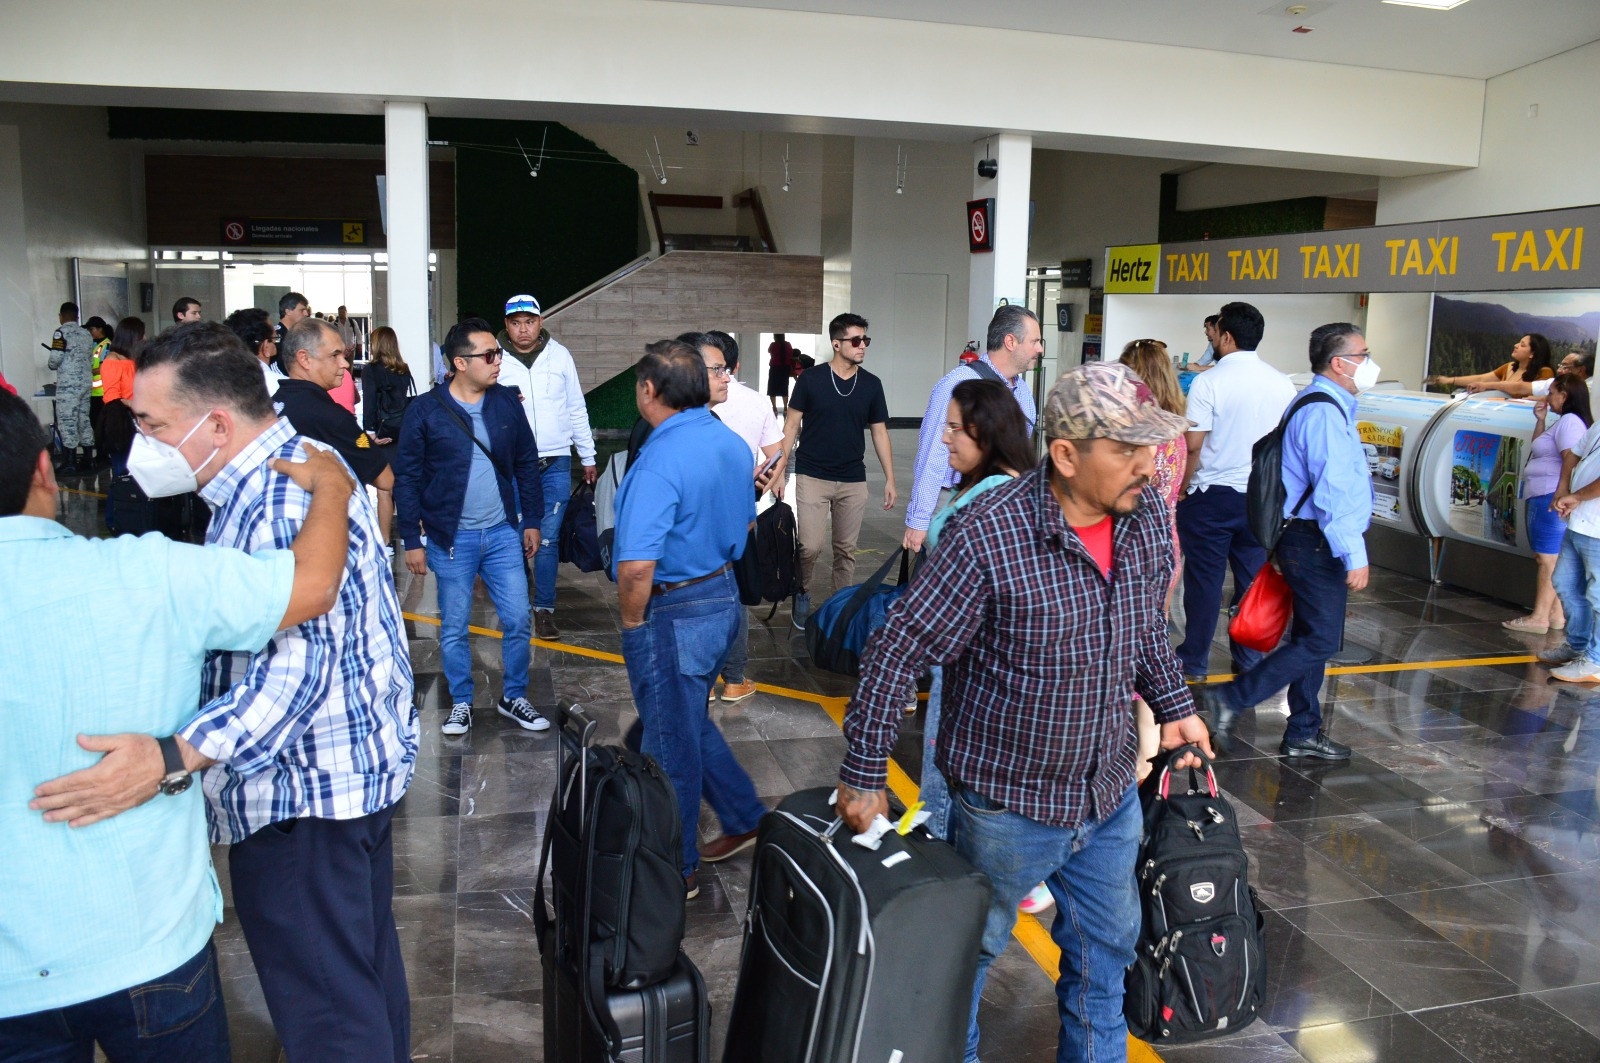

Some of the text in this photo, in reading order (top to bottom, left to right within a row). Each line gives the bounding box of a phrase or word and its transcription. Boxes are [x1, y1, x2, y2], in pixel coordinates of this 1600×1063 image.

[251, 225, 282, 233] Llegadas
[1166, 227, 1585, 282] TAXI TAXI TAXI TAXI TAXI
[1110, 258, 1151, 283] Hertz
